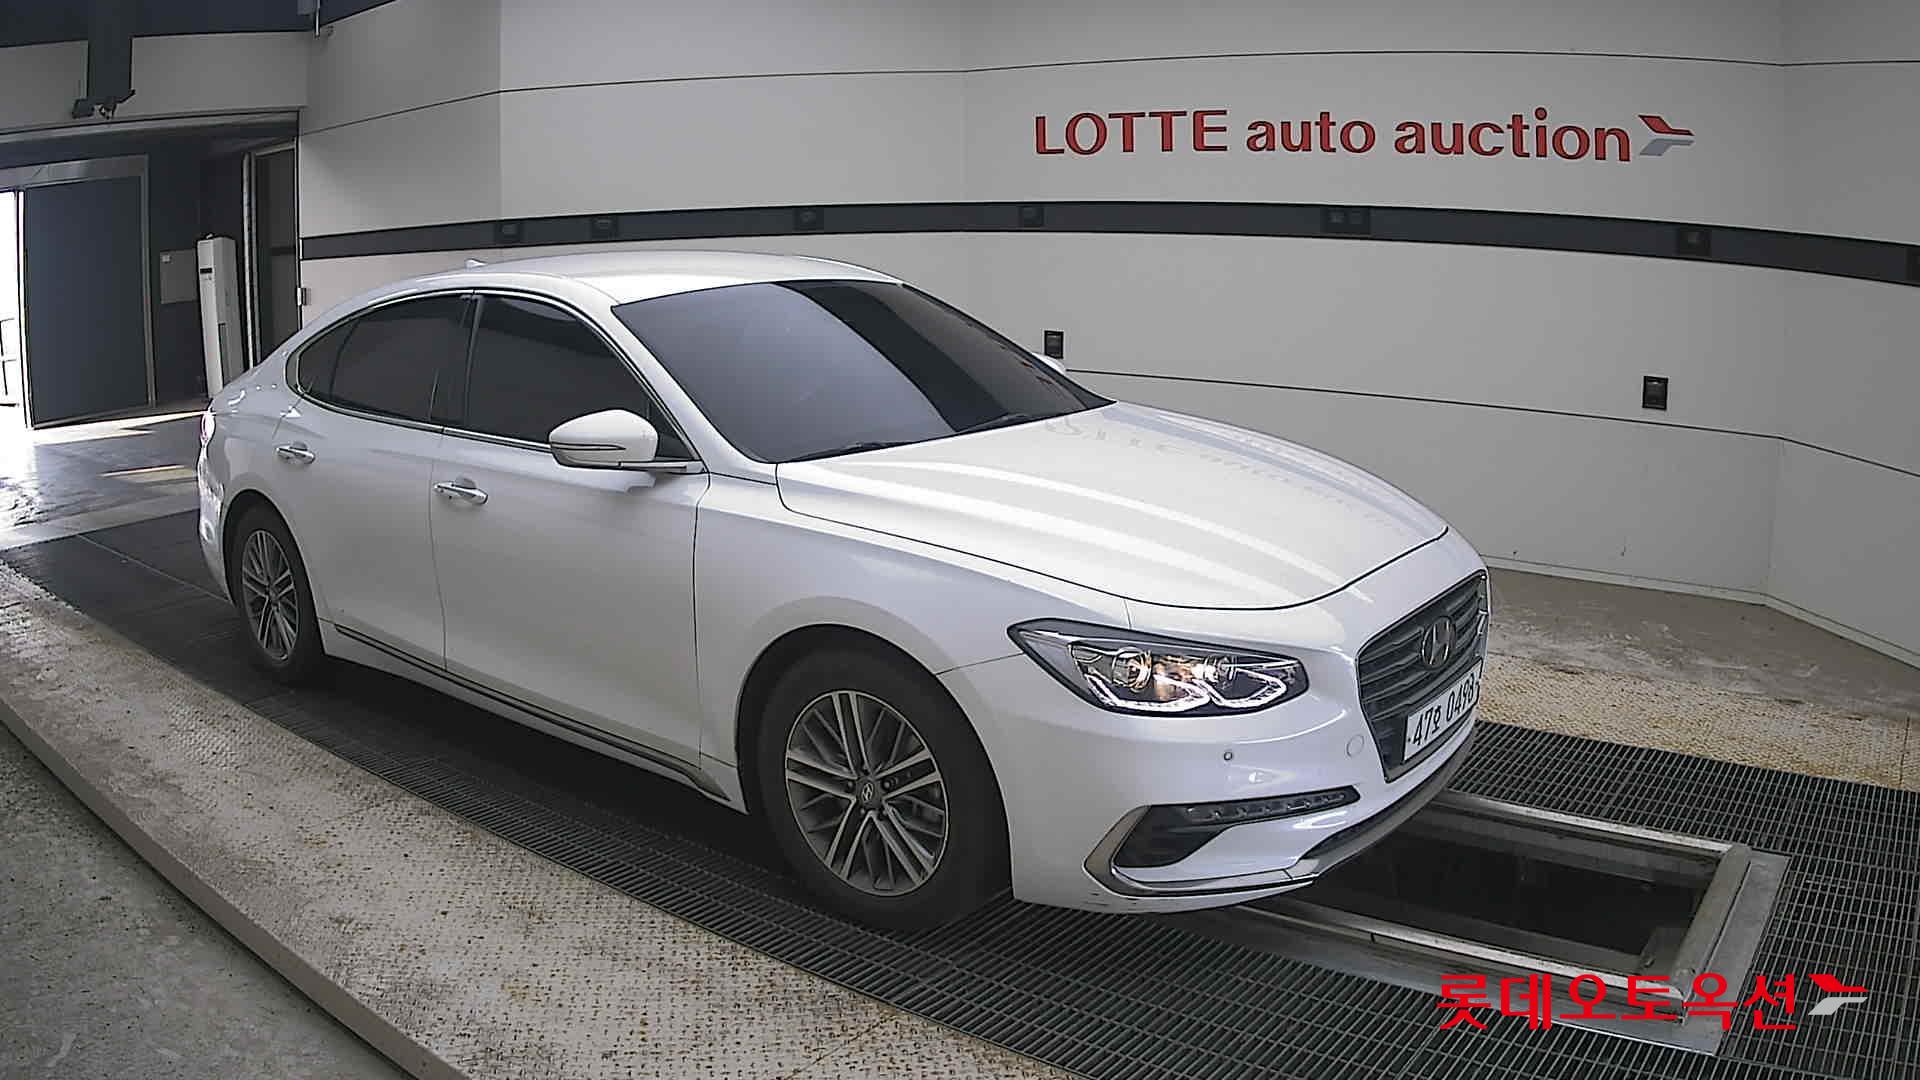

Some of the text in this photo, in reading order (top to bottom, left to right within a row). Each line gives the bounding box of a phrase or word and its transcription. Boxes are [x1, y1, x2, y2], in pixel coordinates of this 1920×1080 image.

[1035, 107, 1631, 162] LOTTE auto auction
